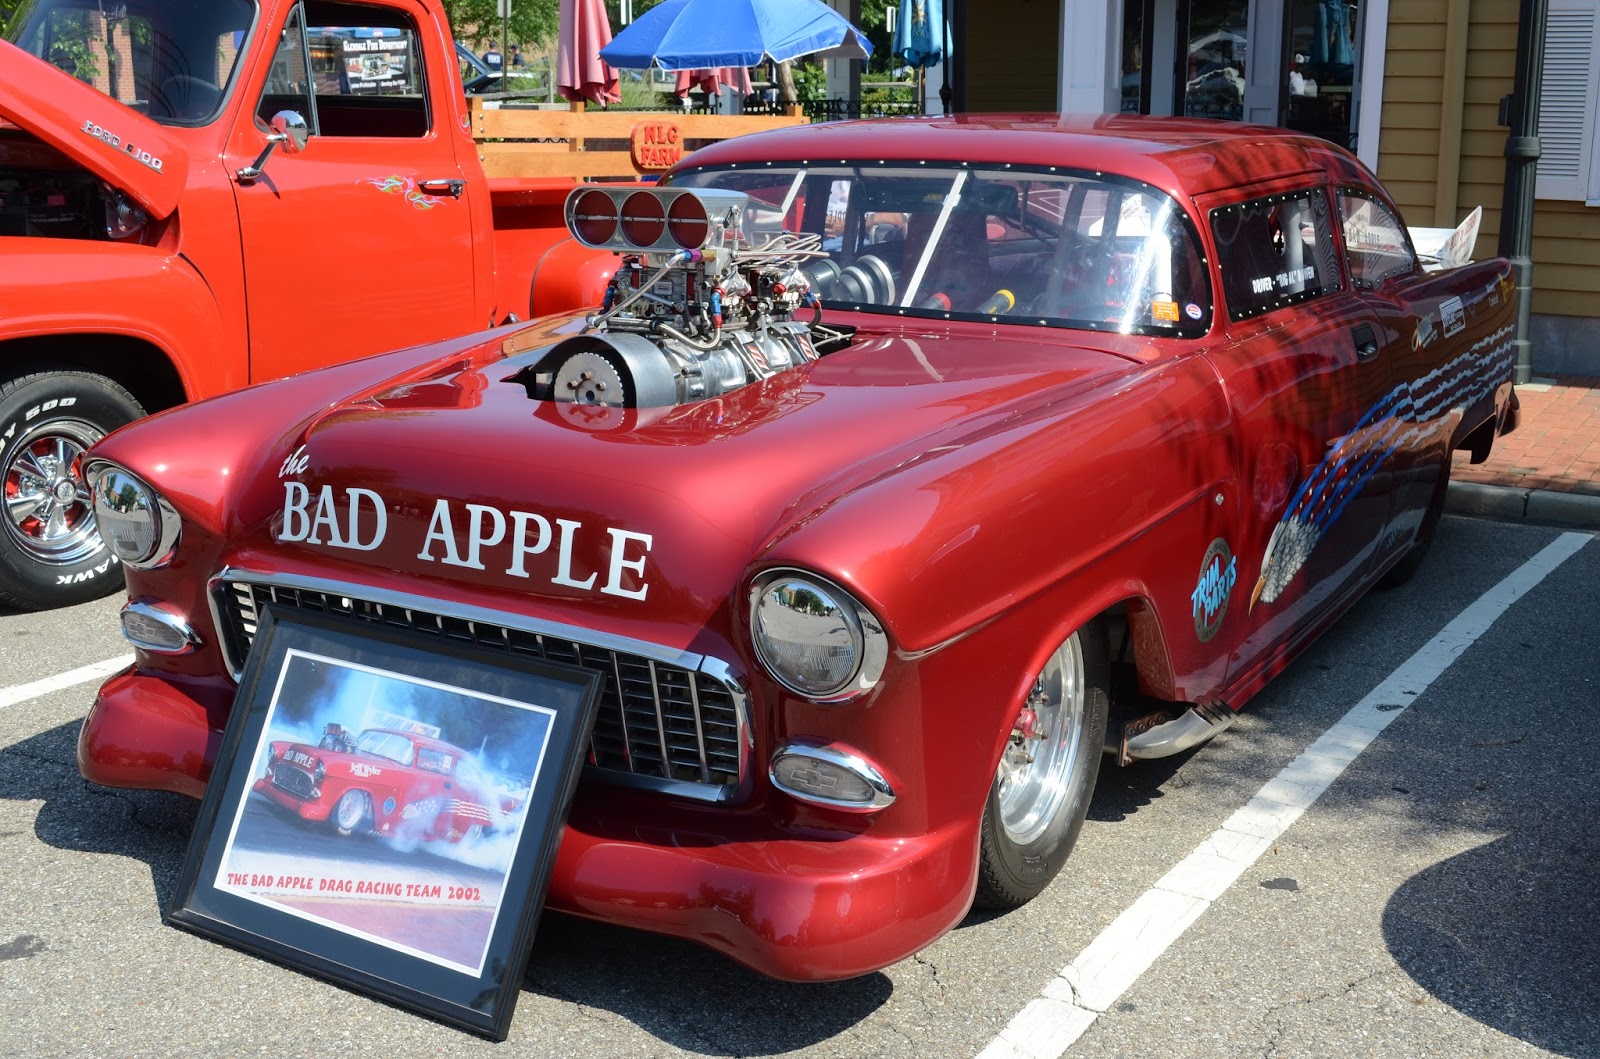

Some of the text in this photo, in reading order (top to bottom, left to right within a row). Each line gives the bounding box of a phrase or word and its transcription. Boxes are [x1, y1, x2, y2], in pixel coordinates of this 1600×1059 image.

[84, 120, 121, 147] FORD
[644, 125, 678, 144] NLG
[641, 147, 681, 166] FARM
[25, 397, 77, 421] 500
[278, 443, 310, 479] the
[278, 481, 653, 602] BAD APPLE
[1191, 556, 1220, 618] TRIM
[1204, 555, 1236, 628] PARTS
[292, 752, 314, 769] APPLE
[227, 873, 480, 901] THE BAD APPLE DRAG RACING TEAM 2002
